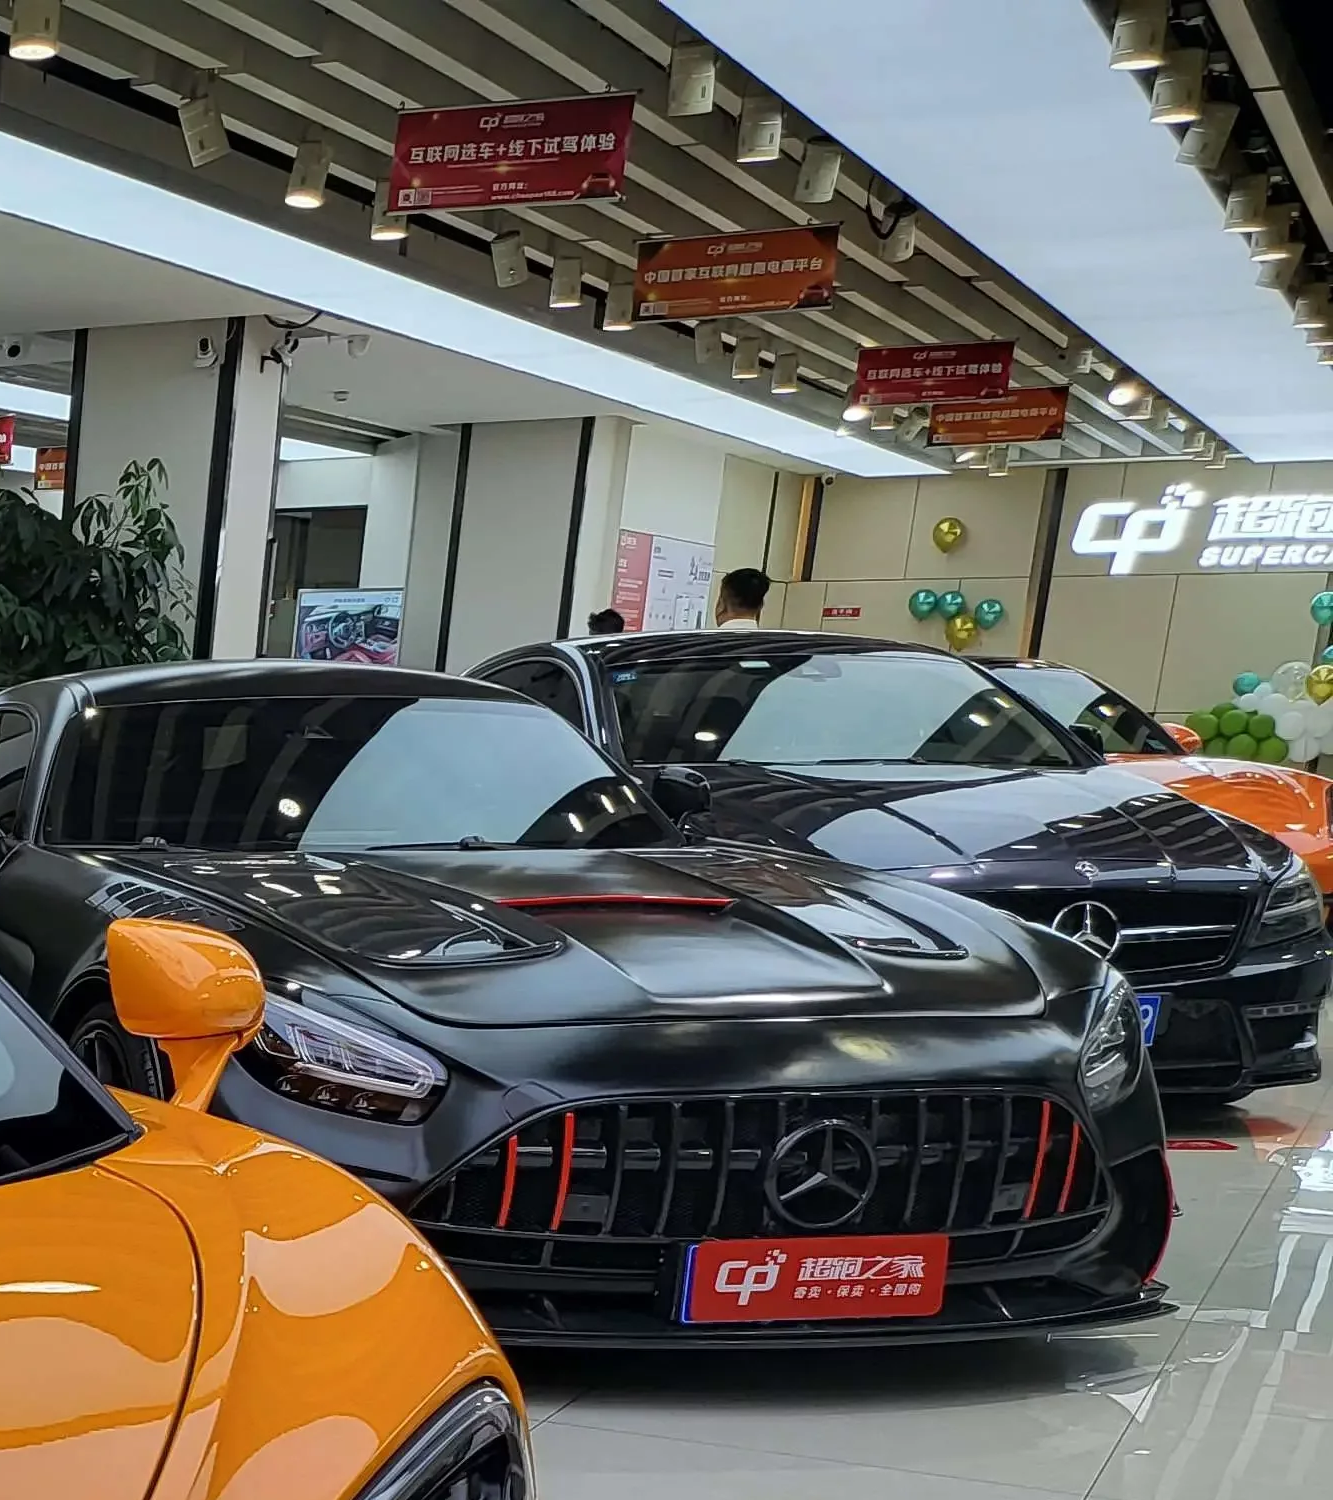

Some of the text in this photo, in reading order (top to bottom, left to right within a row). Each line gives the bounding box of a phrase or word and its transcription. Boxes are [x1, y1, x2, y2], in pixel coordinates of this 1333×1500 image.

[409, 132, 617, 164] 互联网选车+线下试驾体验
[797, 1256, 927, 1281] 超跑之家
